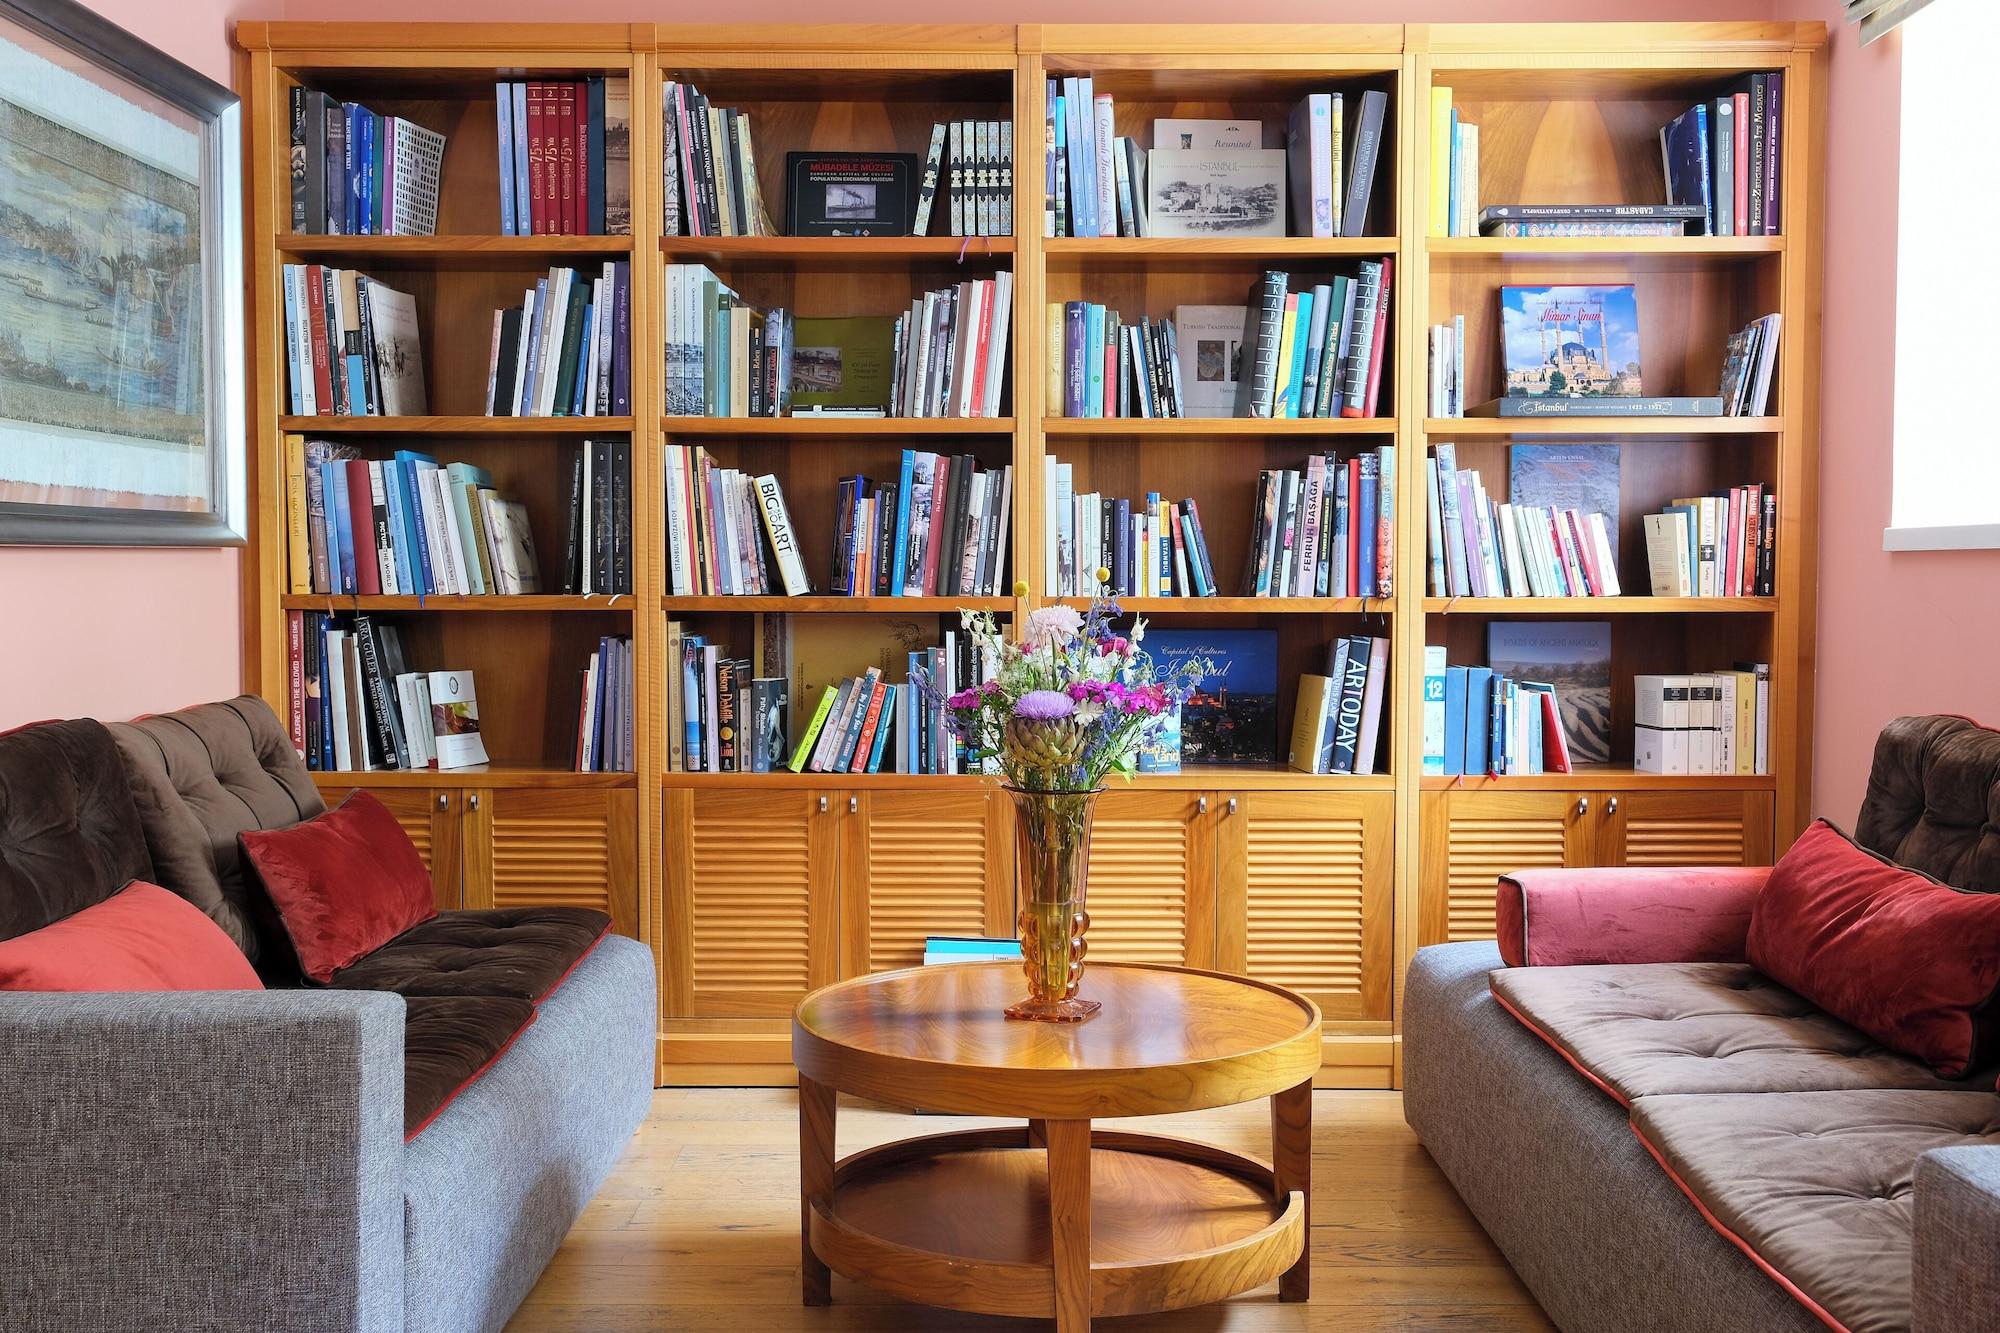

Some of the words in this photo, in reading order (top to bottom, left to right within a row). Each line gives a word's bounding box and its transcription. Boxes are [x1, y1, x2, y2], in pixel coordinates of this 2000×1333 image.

[1752, 84, 1765, 122] MOSAICS
[698, 106, 709, 148] DISCOVERING
[530, 148, 542, 163] 75
[545, 148, 558, 163] 75
[560, 148, 573, 163] 75
[1214, 139, 1252, 149] Reunited
[703, 149, 712, 179] ANTIQUES
[809, 162, 859, 171] MÜBADELE
[1615, 206, 1654, 215] CADASTRE
[357, 290, 367, 323] Damascus
[1261, 284, 1279, 402] KAPADOKYA
[1352, 275, 1374, 393] CAPPADOCIA
[752, 349, 760, 369] Reben
[752, 377, 760, 389] Tod
[1152, 392, 1161, 414] WORK
[761, 483, 780, 510] BIG
[772, 523, 792, 553] ART
[1303, 528, 1315, 572] FERRUH
[1160, 646, 1189, 657] Capital
[1198, 646, 1227, 655] Cultures
[292, 660, 300, 688] BELOVED
[719, 664, 733, 692] Nelson
[1427, 679, 1443, 698] 12
[719, 694, 733, 724] DeMille
[1335, 658, 1367, 754] ARTODAY
[292, 710, 301, 737] JOURNEY
[759, 712, 767, 735] Shades
